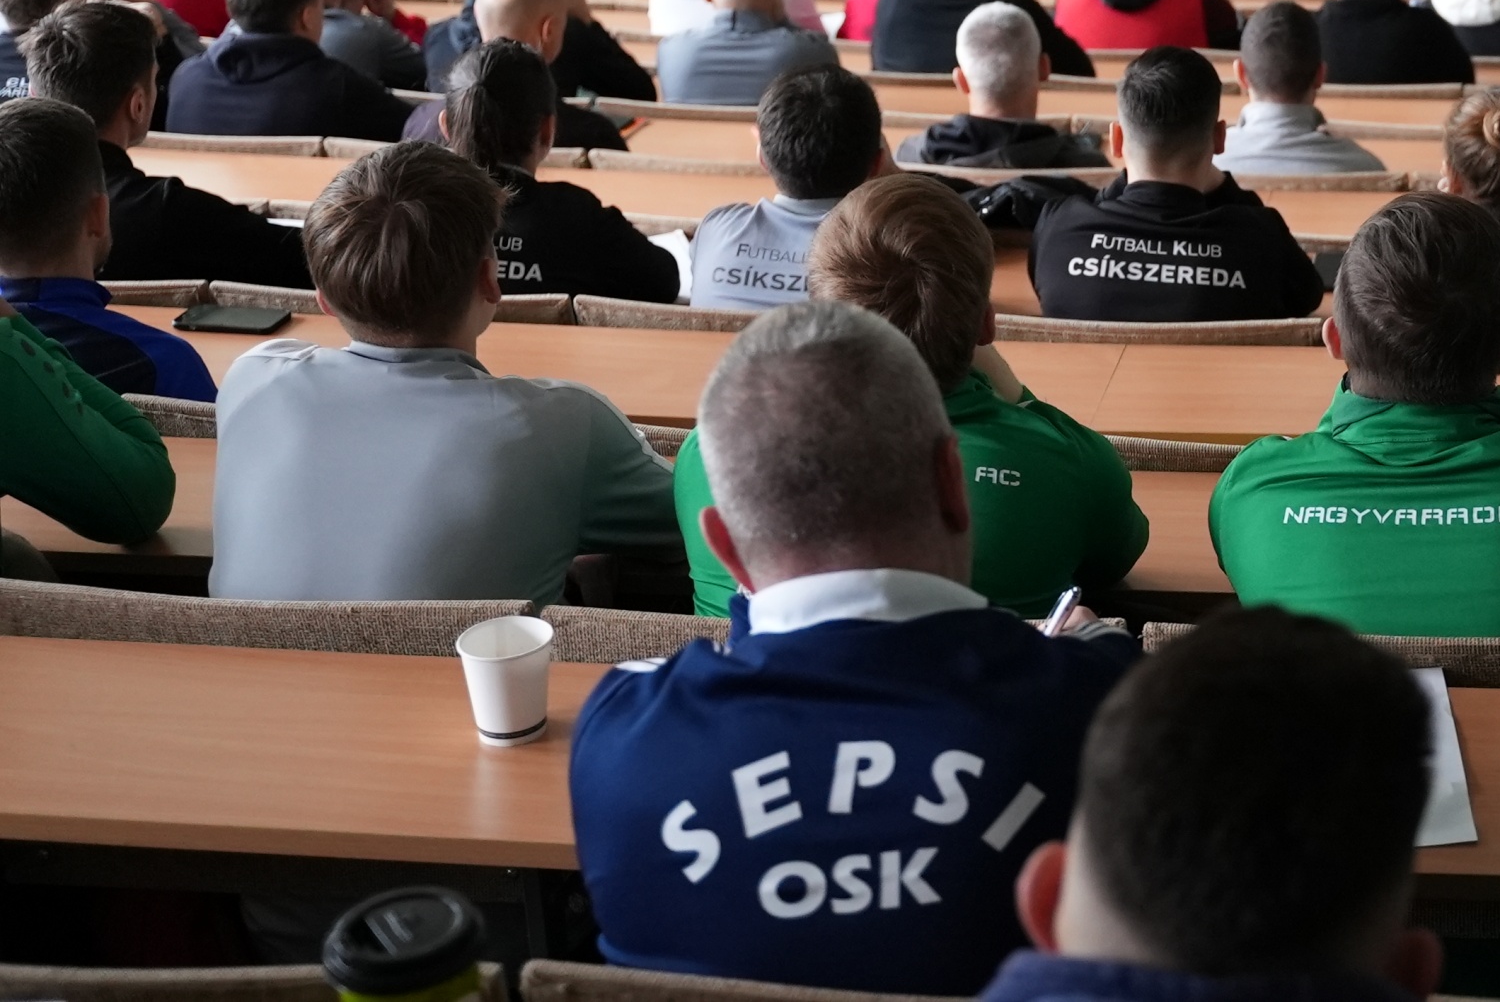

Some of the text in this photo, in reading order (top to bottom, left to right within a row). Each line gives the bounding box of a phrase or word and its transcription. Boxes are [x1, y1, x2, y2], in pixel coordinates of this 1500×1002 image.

[1091, 233, 1222, 258] FUTBALL KLUB
[1068, 254, 1246, 288] CSÍKSZEREDA
[974, 466, 1021, 487] AC
[661, 740, 1046, 883] SEPSI
[758, 847, 942, 920] OSK
